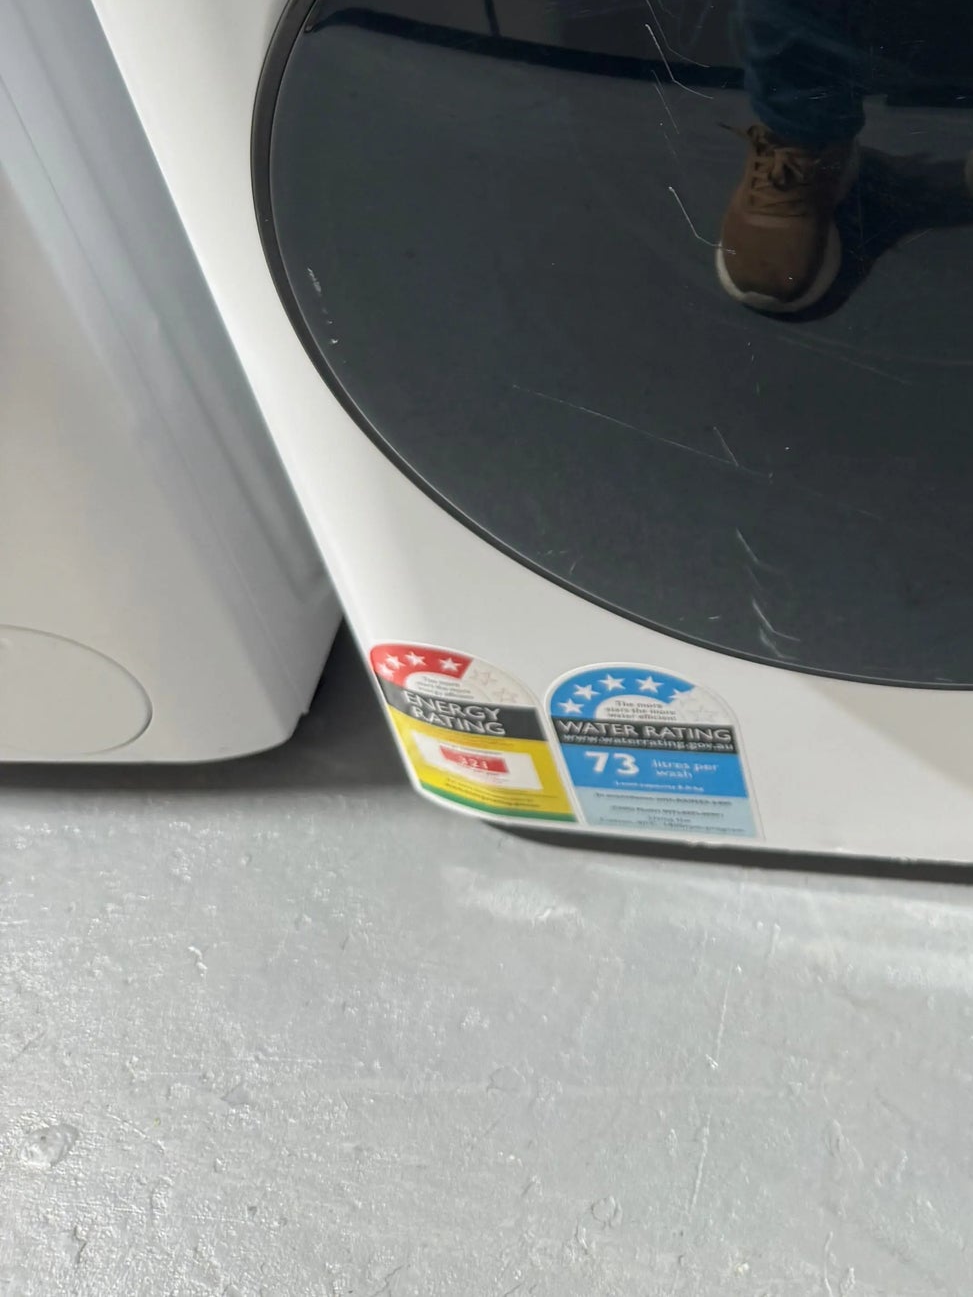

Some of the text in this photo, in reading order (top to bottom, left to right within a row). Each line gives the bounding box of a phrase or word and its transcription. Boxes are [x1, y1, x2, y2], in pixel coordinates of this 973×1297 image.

[403, 690, 502, 722] ENERGY
[411, 706, 506, 736] RATING
[558, 719, 732, 741] WATER RATING
[584, 750, 640, 775] 73
[652, 758, 719, 773] litres per
[656, 769, 694, 779] wash
